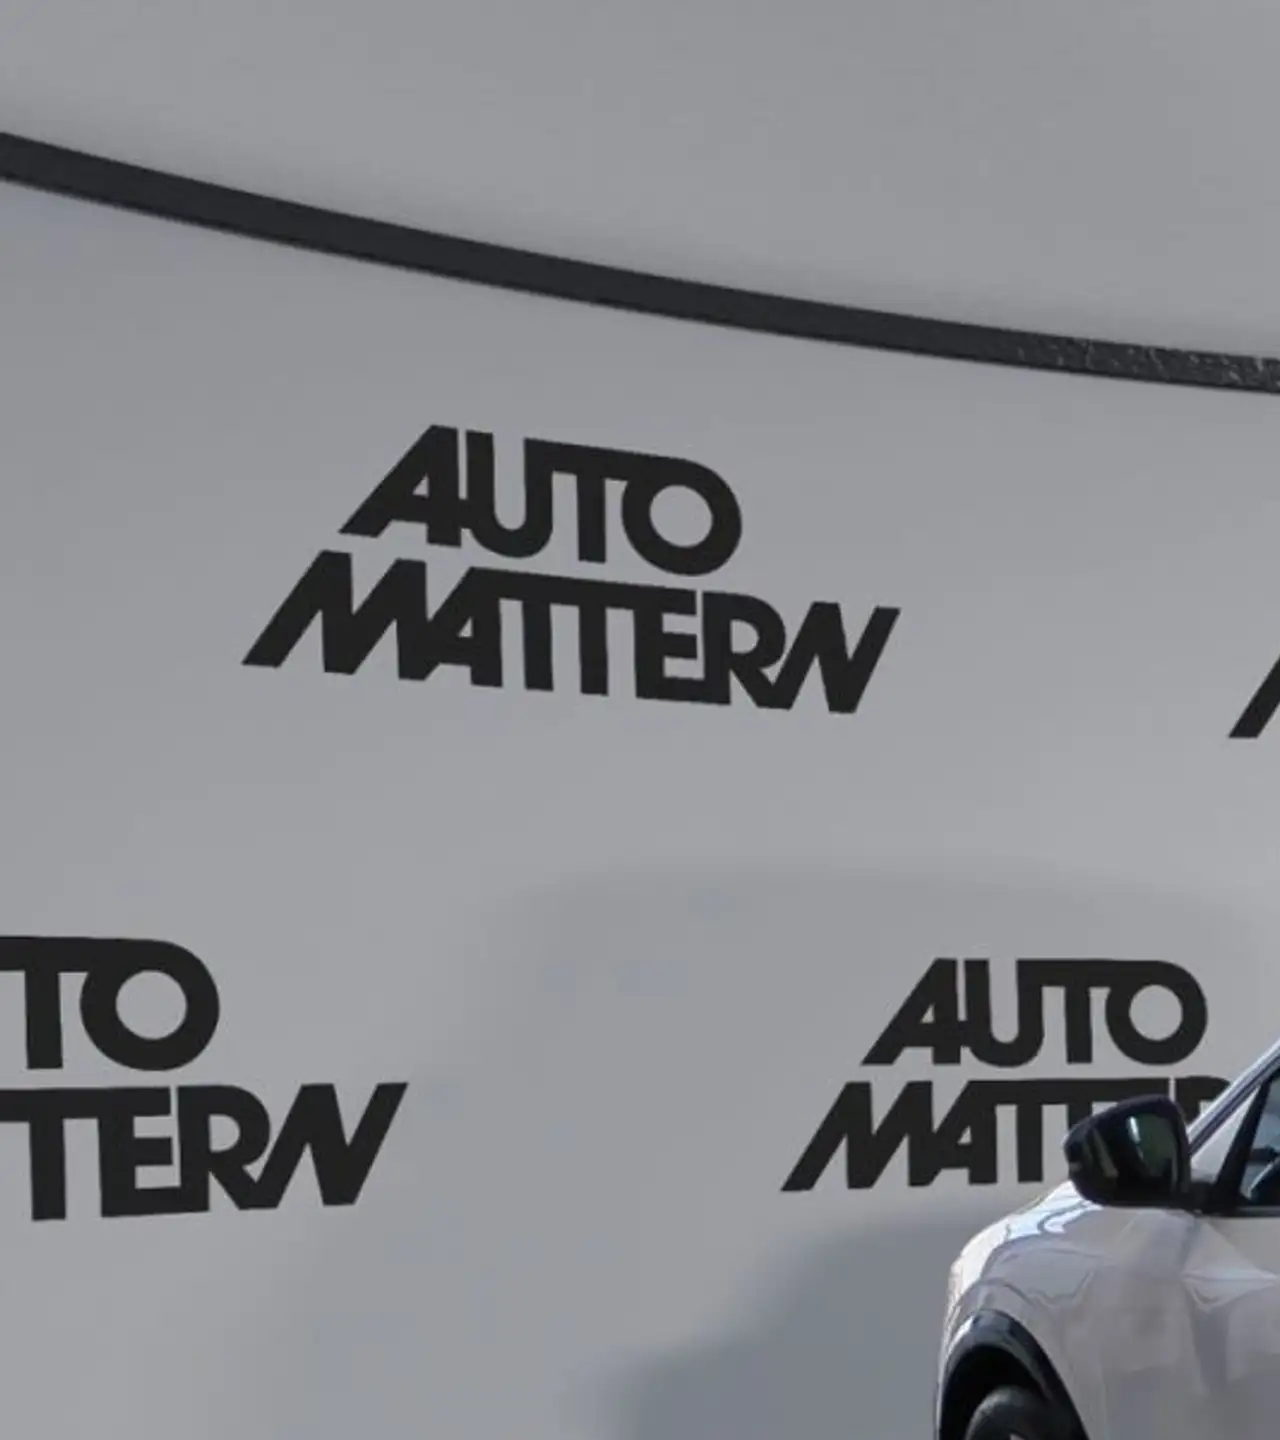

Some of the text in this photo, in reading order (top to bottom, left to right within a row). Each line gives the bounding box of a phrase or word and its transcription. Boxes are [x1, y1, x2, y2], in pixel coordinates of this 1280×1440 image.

[339, 425, 741, 576] AUTO
[242, 550, 900, 714] MATTERN
[0, 936, 220, 1071] TO
[861, 957, 1208, 1067] AUTO
[0, 1082, 408, 1221] TERN
